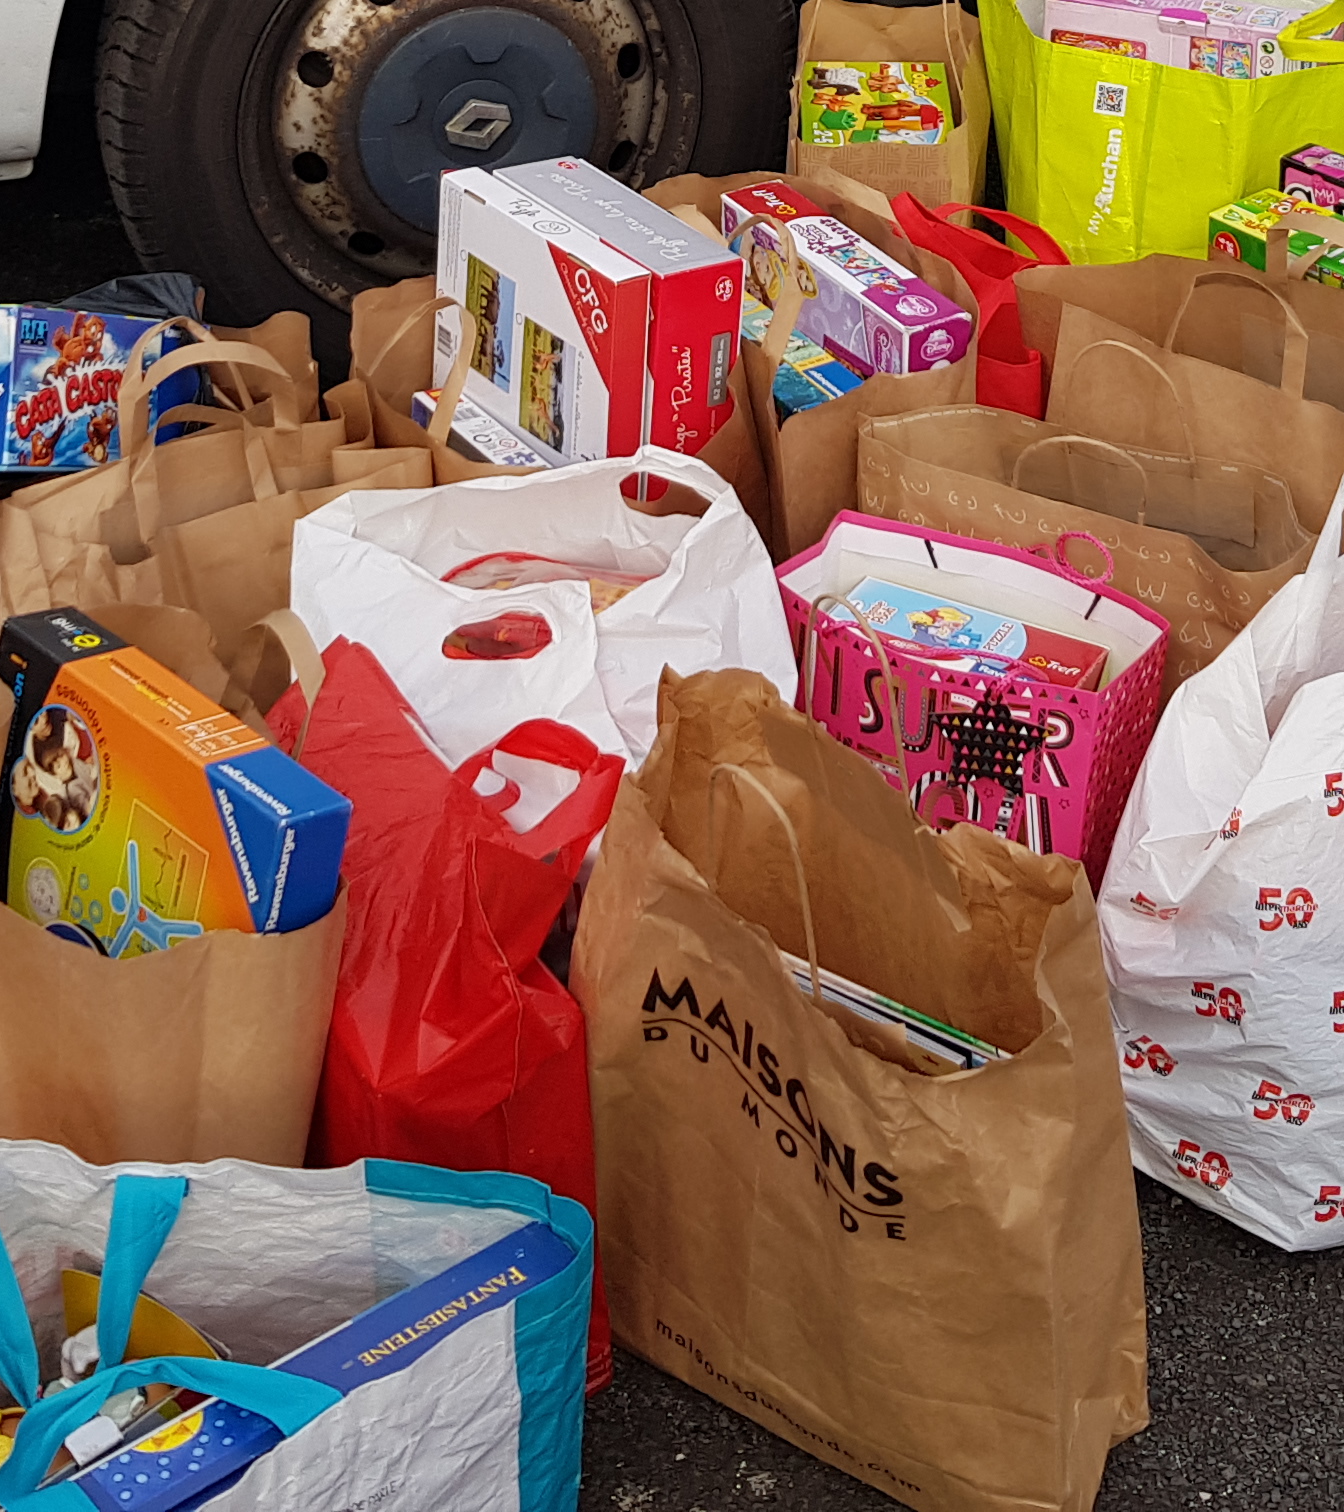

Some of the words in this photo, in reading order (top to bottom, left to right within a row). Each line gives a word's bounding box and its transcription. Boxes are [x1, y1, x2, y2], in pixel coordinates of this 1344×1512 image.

[1094, 128, 1123, 215] Auchan
[573, 268, 609, 334] CFG
[15, 387, 63, 438] CATA
[983, 622, 1015, 651] PUZZLE
[859, 668, 1073, 787] SUR
[217, 764, 292, 816] Ravensburger
[216, 788, 259, 903] Ravensburger
[264, 828, 296, 931] Ravensburger
[1259, 887, 1314, 931] 50
[1193, 982, 1243, 1022] 50
[1124, 1034, 1177, 1077] 50
[640, 966, 904, 1207] MAISONS
[1253, 1079, 1312, 1124] 50
[740, 1091, 907, 1242] MONDE
[1176, 1139, 1230, 1191] 50
[358, 1266, 528, 1367] FANTASIESTEINE
